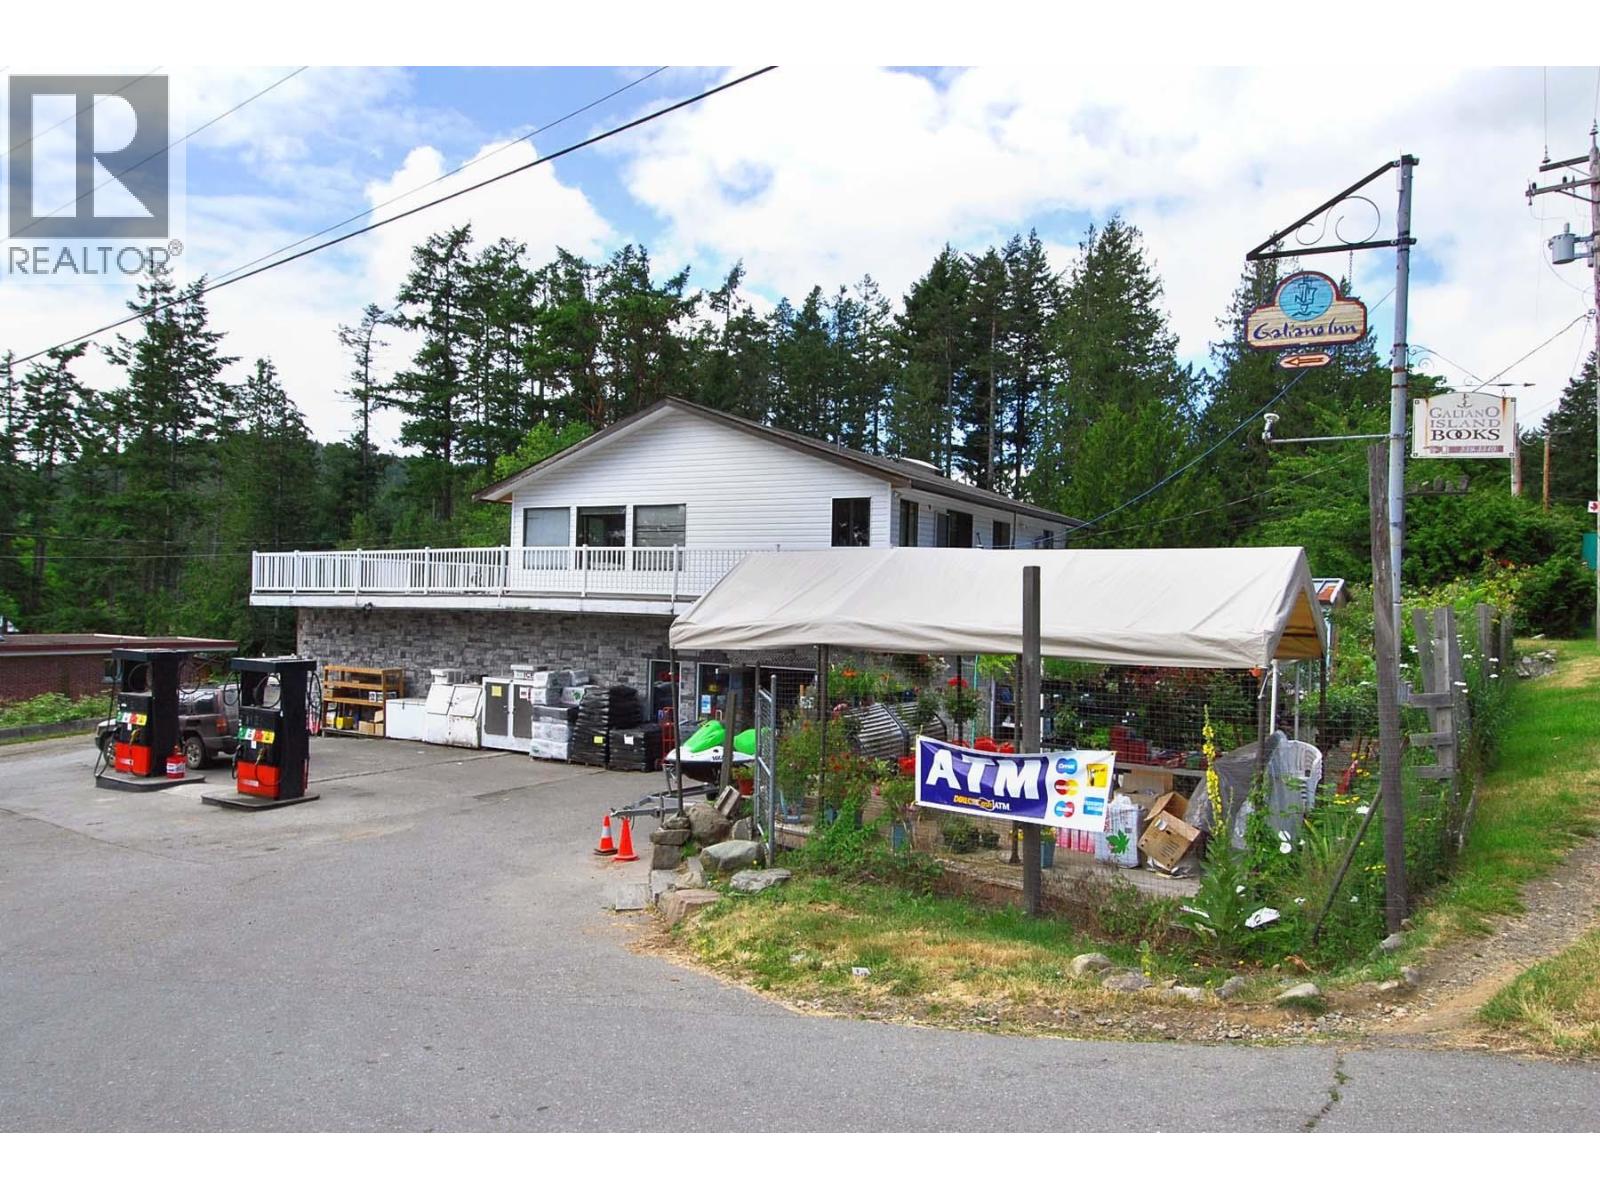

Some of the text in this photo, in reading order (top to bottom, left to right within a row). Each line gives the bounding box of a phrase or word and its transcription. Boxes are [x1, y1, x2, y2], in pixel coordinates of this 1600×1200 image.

[1253, 317, 1358, 340] Galiano Inn
[1429, 406, 1500, 419] GALIANO
[1430, 419, 1501, 428] ISLAND
[1431, 428, 1500, 441] BOOKS
[925, 749, 1042, 800] ATM
